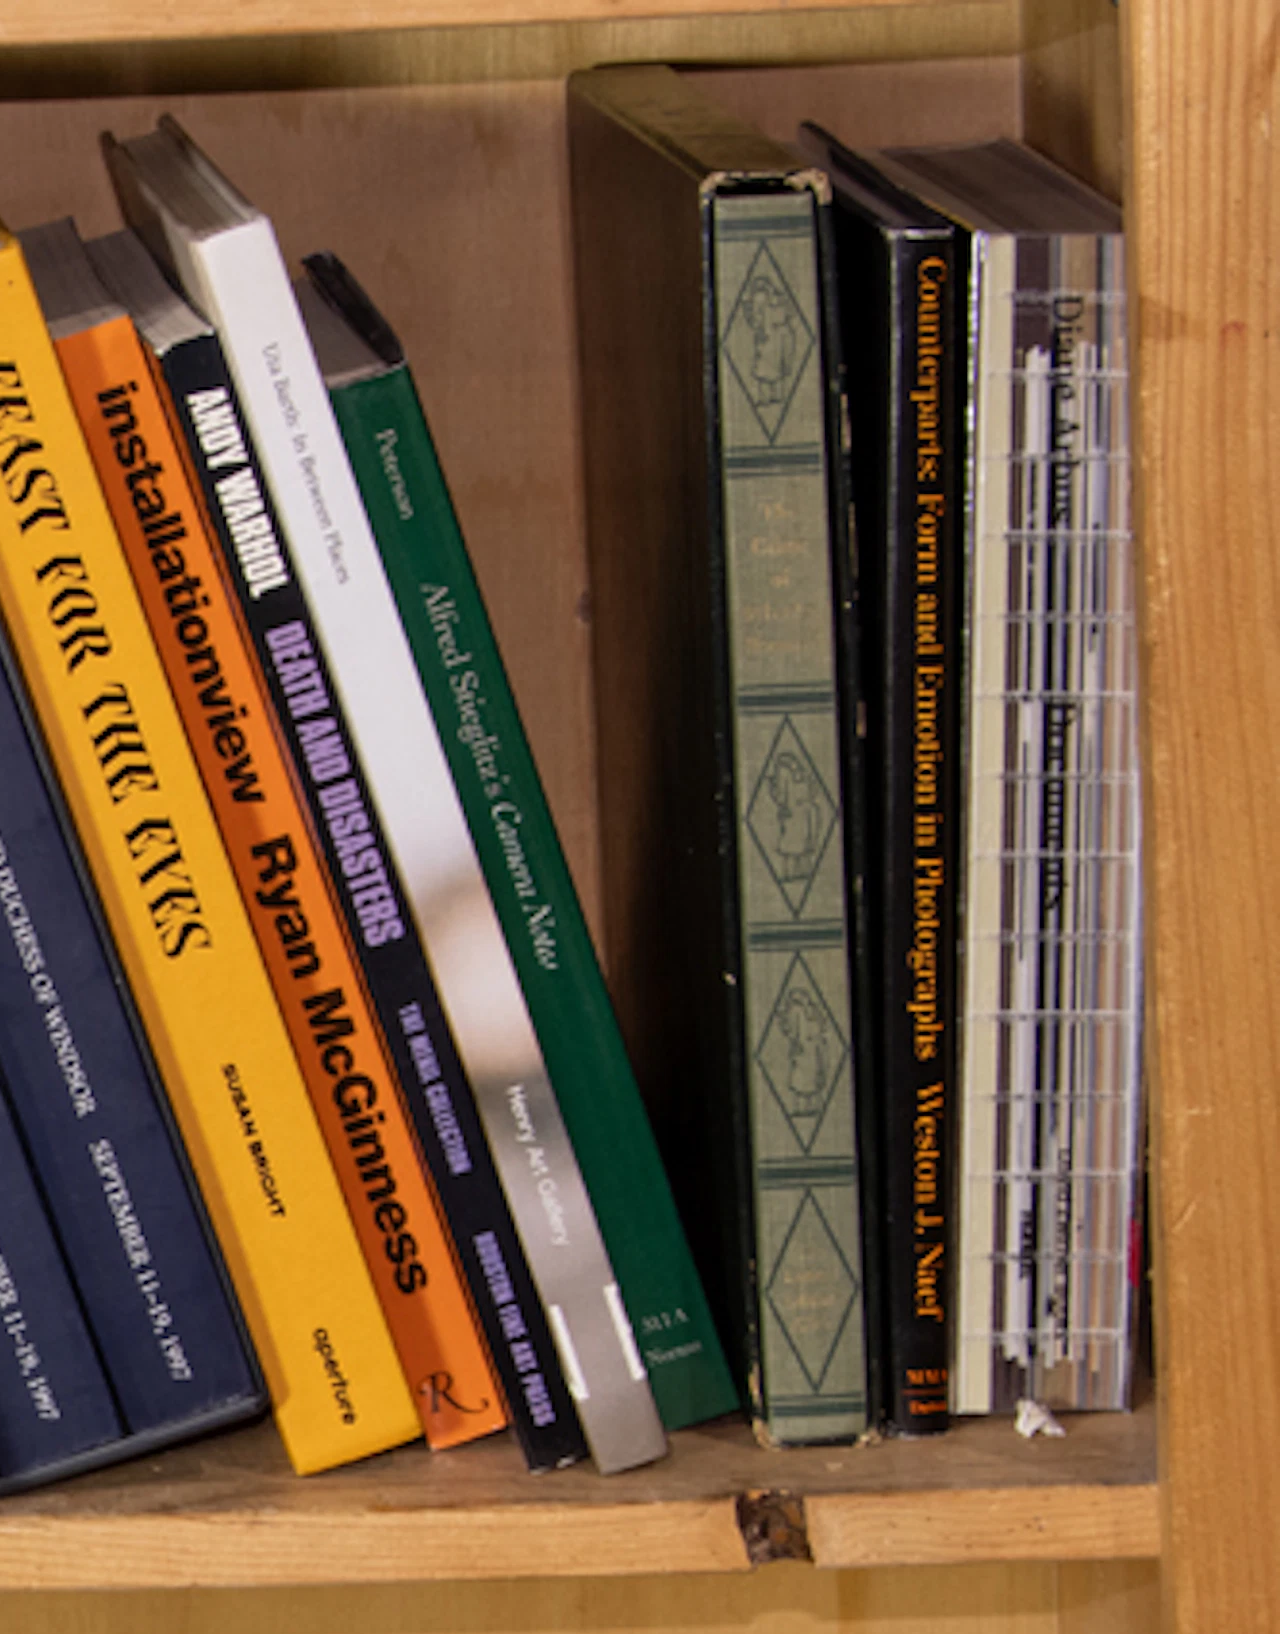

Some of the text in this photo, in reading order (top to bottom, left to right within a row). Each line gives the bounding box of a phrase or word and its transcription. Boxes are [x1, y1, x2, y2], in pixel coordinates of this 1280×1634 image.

[916, 493, 945, 584] Form
[185, 385, 407, 950] ANDY WARHOL DEATH AND DISASTERS
[914, 593, 944, 655] and
[35, 555, 113, 674] FOR
[81, 682, 160, 806] THE
[125, 815, 213, 960] EYES
[420, 583, 472, 670] Alfred
[491, 801, 537, 898] Camera
[914, 664, 945, 806] Emotion
[97, 380, 428, 1296] installationview Ryan McGinness
[914, 813, 944, 847] in
[30, 972, 60, 1006] OF
[906, 857, 945, 1061] Photographs
[43, 1003, 99, 1119] WINDSOR
[90, 1138, 150, 1269] SEPTEMBER
[222, 1062, 286, 1219] SUSAN BRIGHT
[505, 1084, 571, 1247] Henry Art Gallery
[913, 1081, 945, 1323] Weston J. Naef
[312, 1327, 356, 1426] aperture
